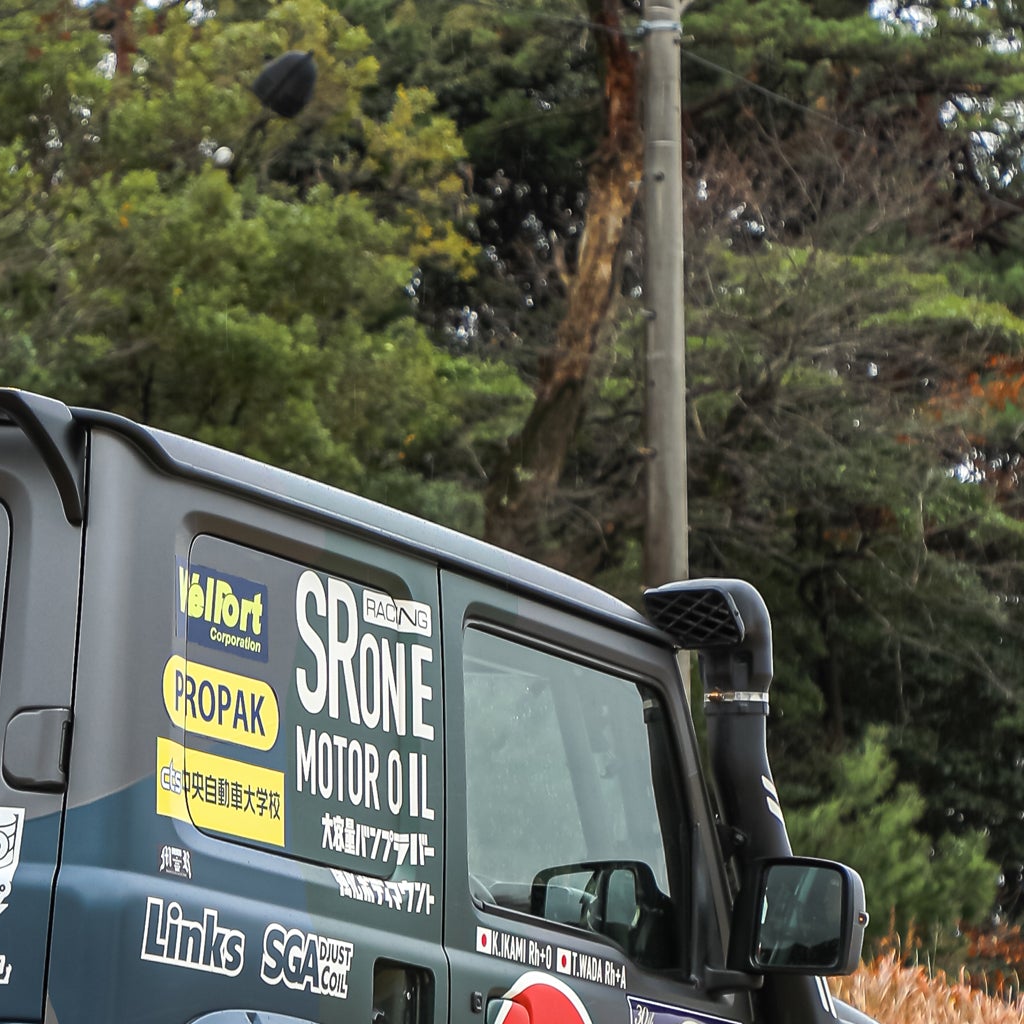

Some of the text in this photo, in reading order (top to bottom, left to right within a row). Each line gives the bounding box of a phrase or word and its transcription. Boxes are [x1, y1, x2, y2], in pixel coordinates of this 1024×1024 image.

[366, 599, 428, 629] RACING
[209, 626, 262, 653] Corporation
[175, 669, 266, 737] PROPAK
[296, 725, 435, 820] MOTOR OIL
[141, 897, 246, 977] Links
[492, 930, 526, 963] K.IKAMI
[571, 951, 602, 983] T.WADA
